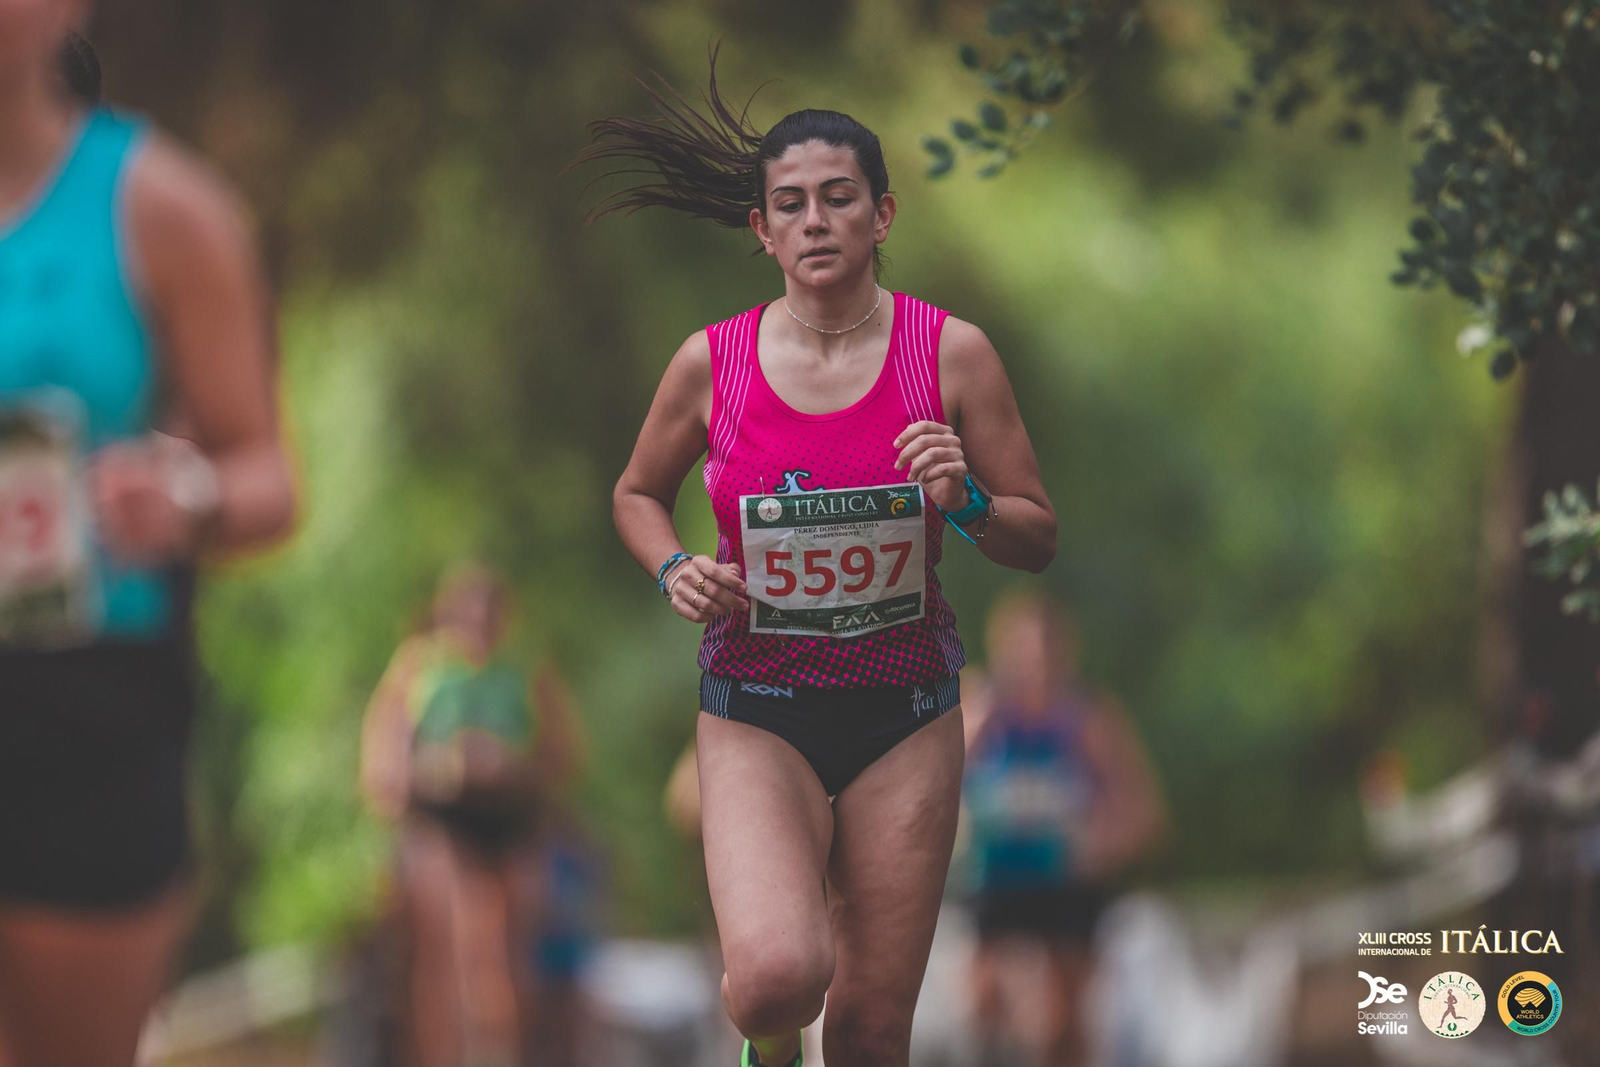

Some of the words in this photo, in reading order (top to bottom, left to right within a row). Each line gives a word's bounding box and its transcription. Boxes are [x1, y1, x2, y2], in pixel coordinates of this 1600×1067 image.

[794, 494, 878, 516] ITÁLICA
[859, 522, 879, 530] LIDIA
[813, 530, 860, 539] INDEPENDIENTE
[765, 540, 913, 597] 5597
